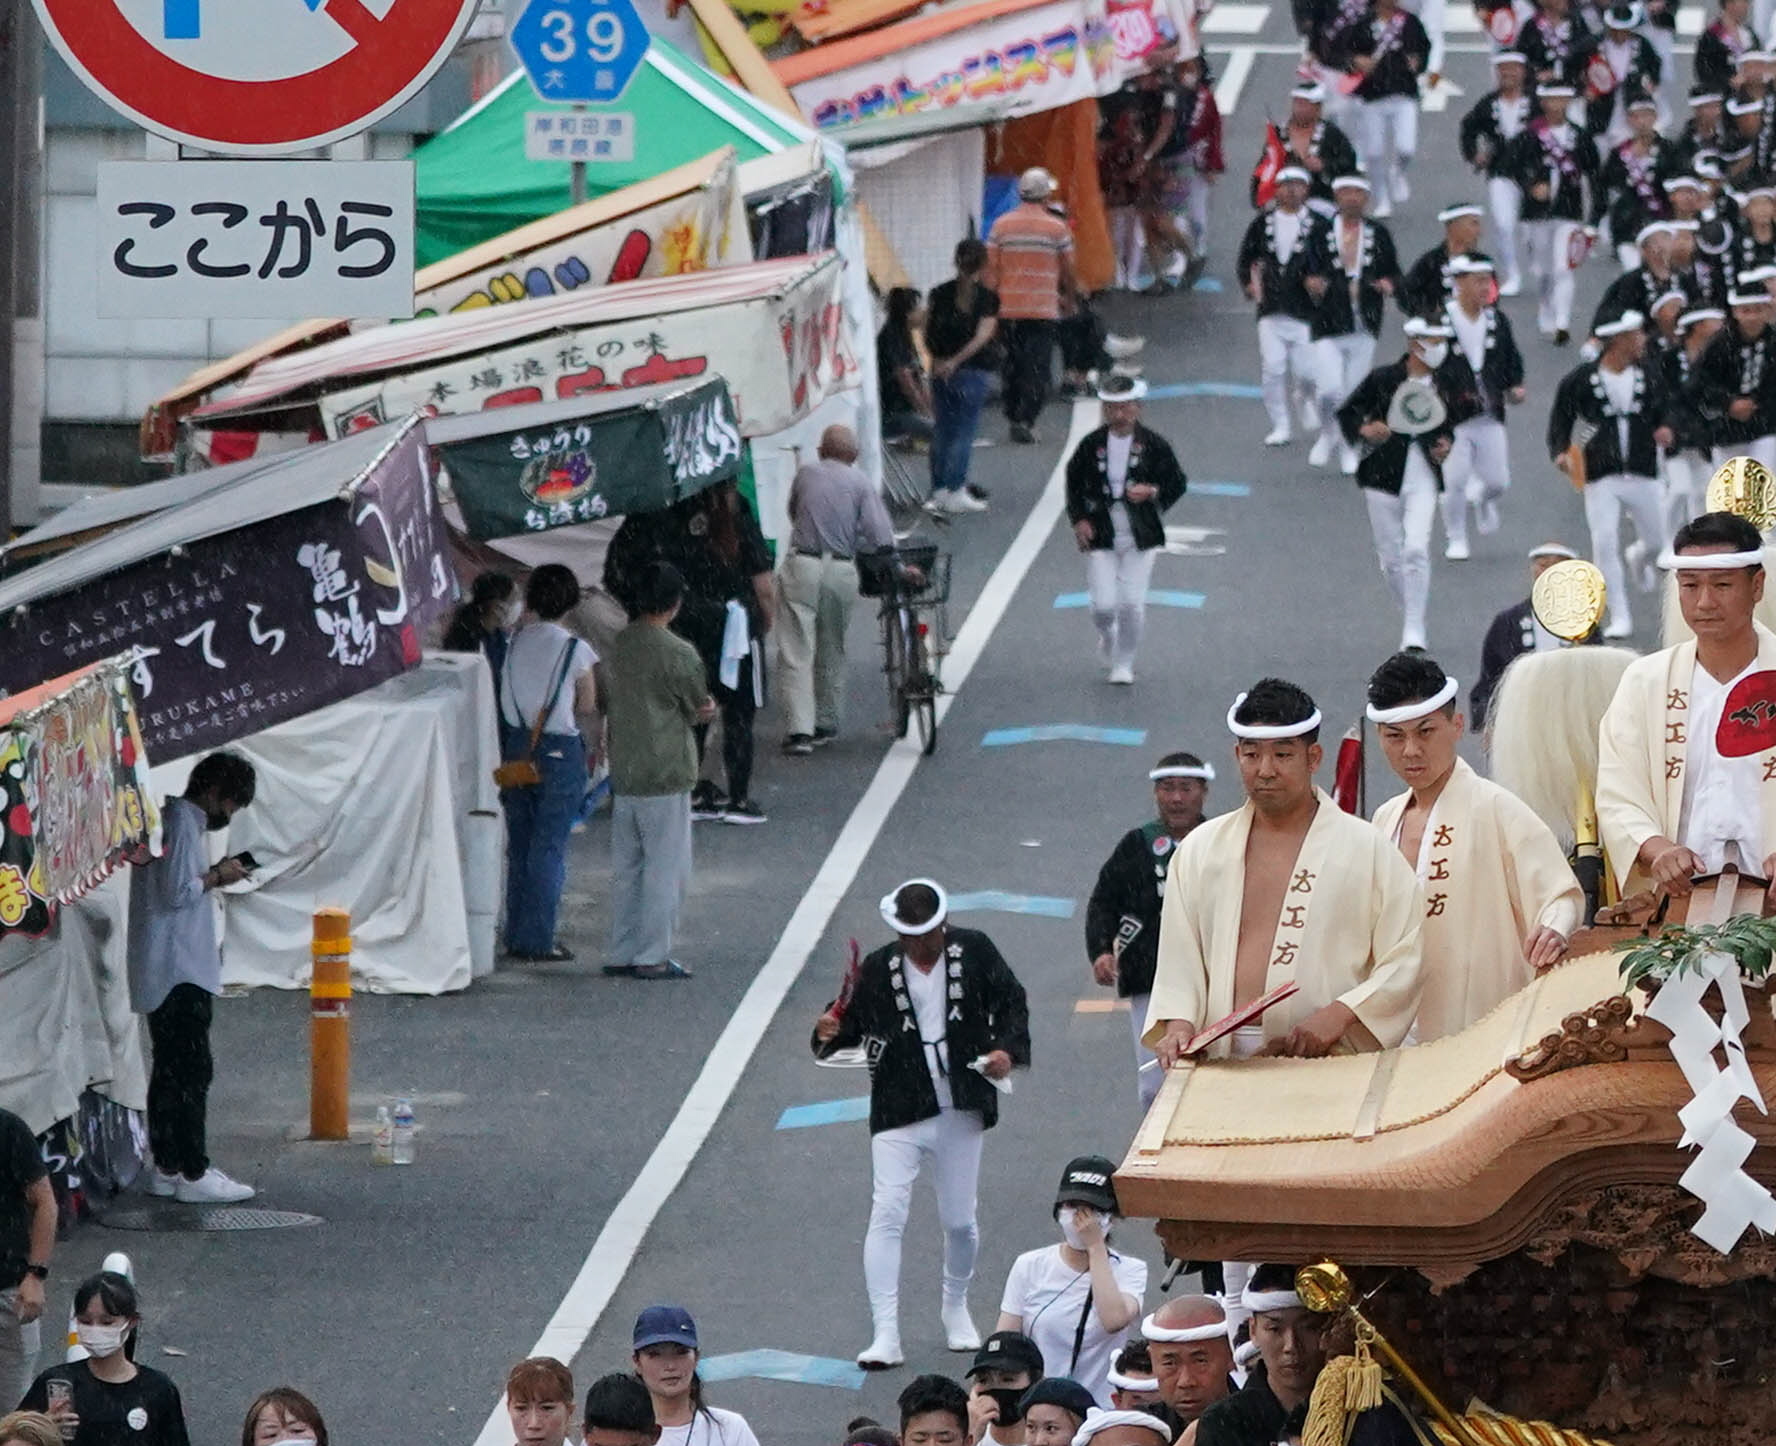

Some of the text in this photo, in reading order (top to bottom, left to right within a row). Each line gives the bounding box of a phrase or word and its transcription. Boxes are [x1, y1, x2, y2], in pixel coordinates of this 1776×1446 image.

[541, 10, 625, 62] 39
[114, 200, 396, 279] ここから
[427, 331, 668, 402] 本場浪花の味
[40, 563, 237, 647] CASTELLA
